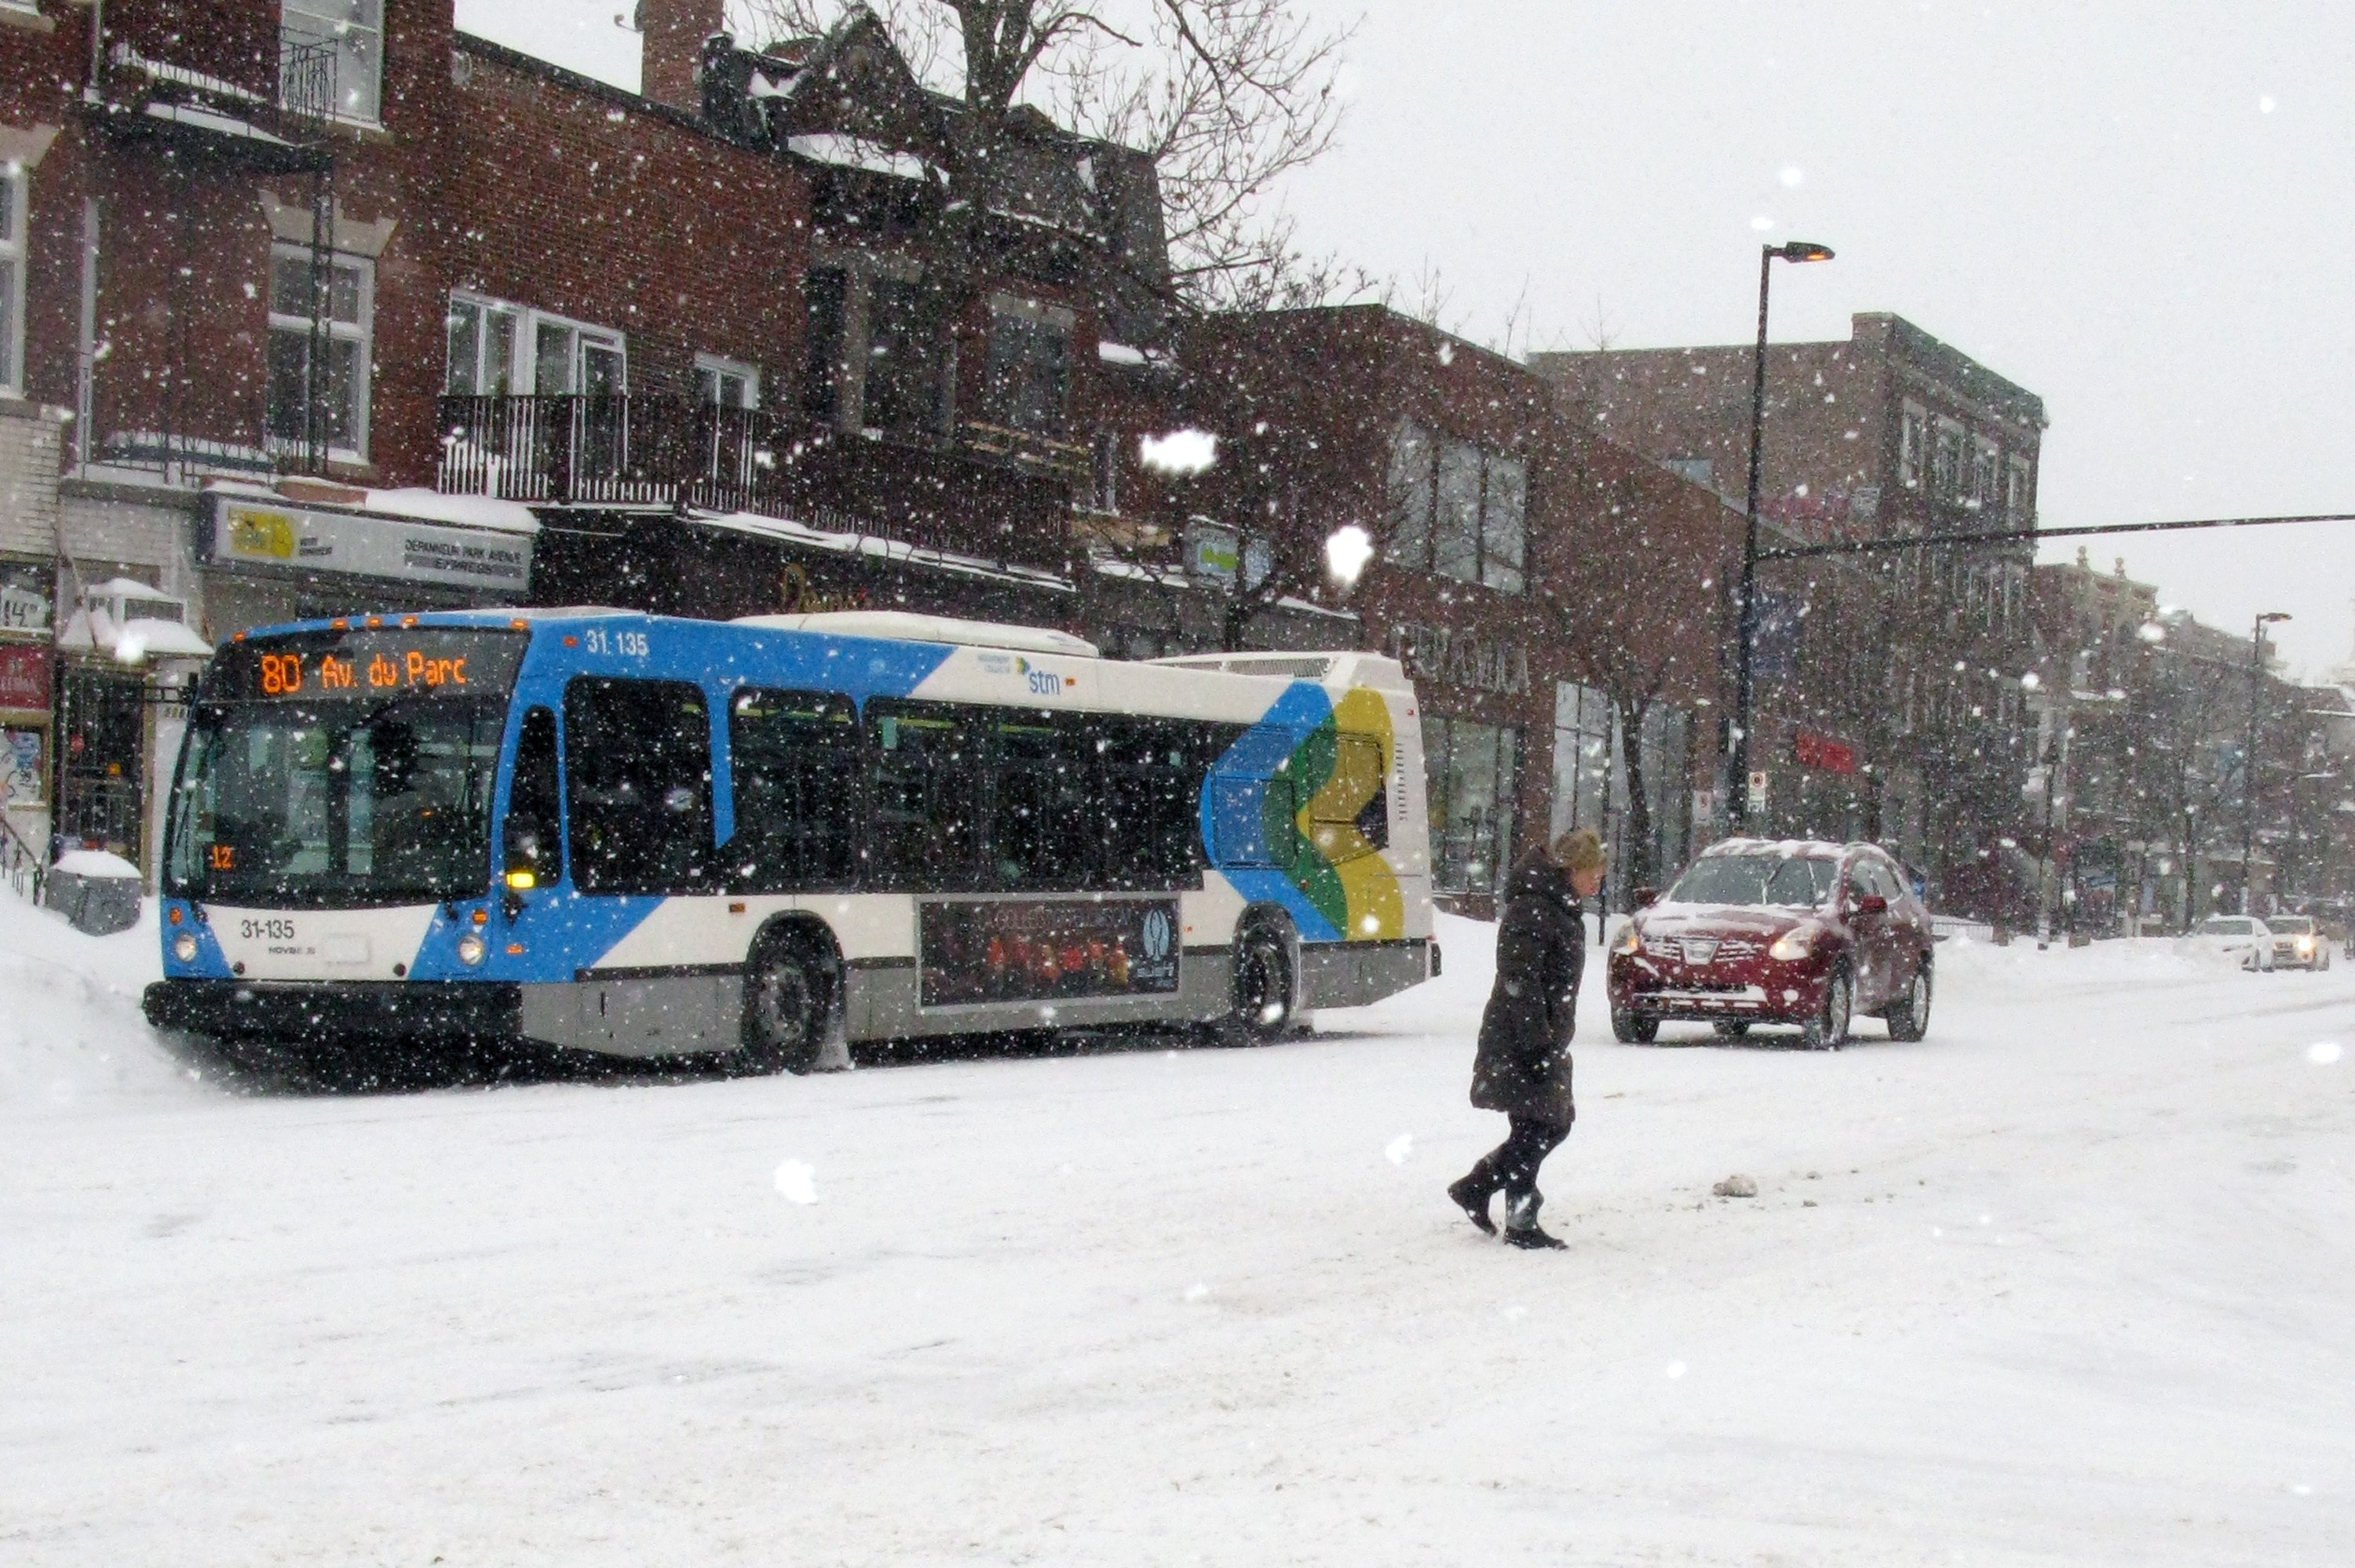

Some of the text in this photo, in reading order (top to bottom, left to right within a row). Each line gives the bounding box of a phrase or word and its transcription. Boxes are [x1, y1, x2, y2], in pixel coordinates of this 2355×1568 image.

[261, 650, 467, 694] 80 Av. du Parc
[1029, 670, 1061, 695] stm
[241, 919, 295, 939] 31-135
